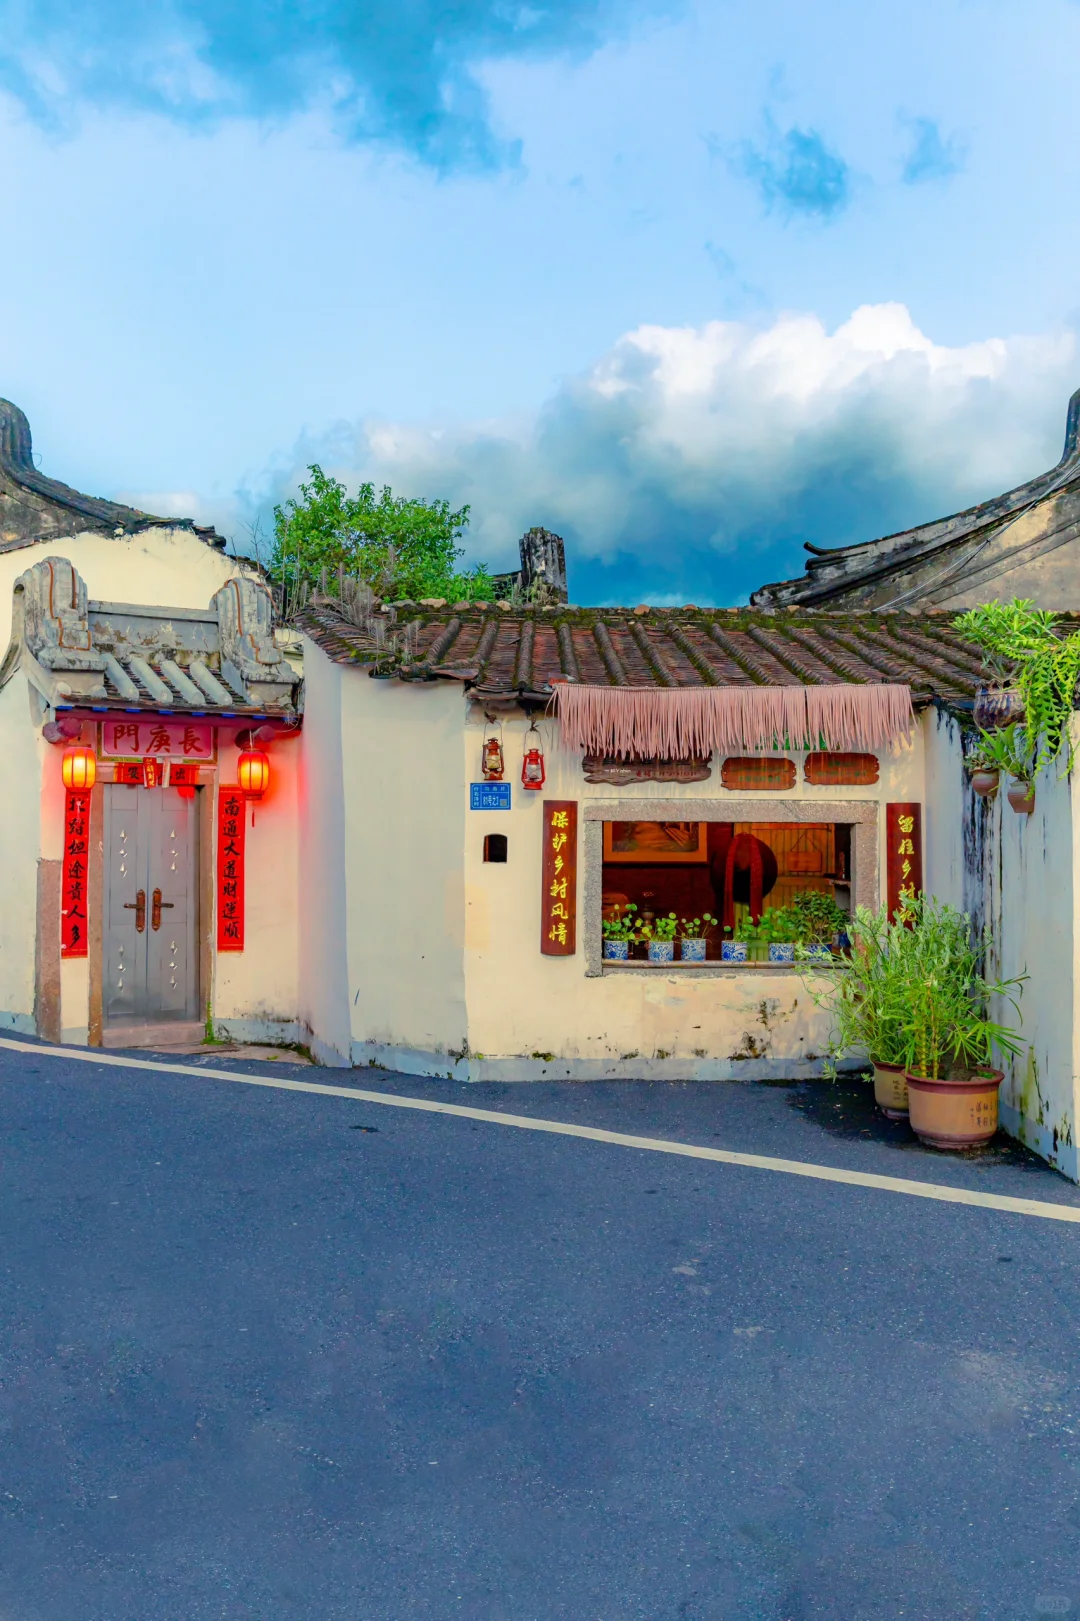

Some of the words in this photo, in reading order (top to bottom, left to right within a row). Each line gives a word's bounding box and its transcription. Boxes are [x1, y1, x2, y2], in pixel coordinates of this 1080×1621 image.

[222, 796, 241, 940] 南通大道財運順
[549, 811, 569, 945] 保护乡村风情
